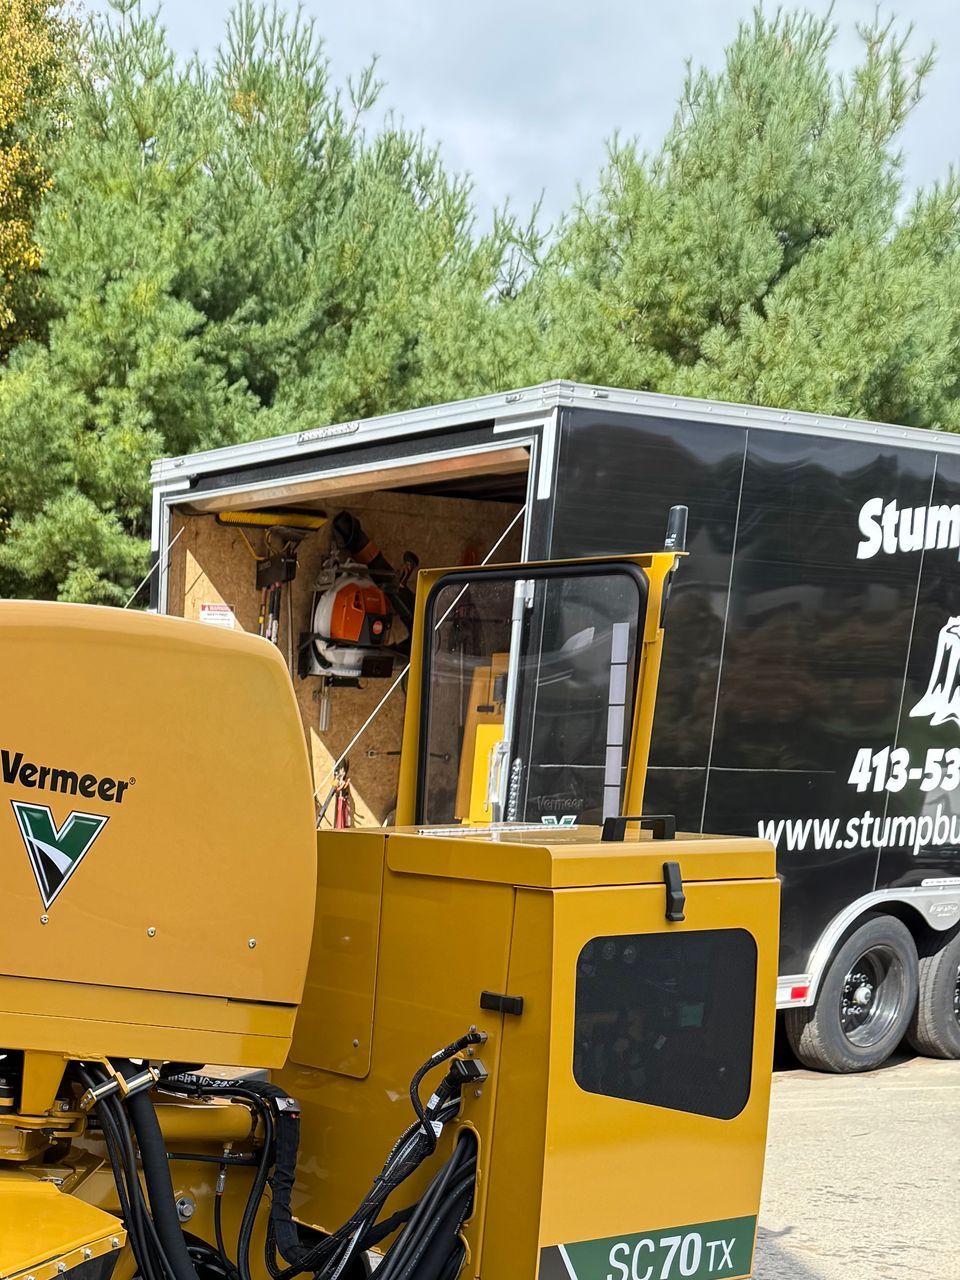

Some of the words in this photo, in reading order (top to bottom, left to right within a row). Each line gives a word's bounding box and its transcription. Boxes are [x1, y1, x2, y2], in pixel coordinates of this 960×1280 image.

[856, 497, 960, 562] Stum
[0, 749, 130, 803] Vermeer
[847, 746, 960, 792] 413-53
[706, 1237, 736, 1272] TX
